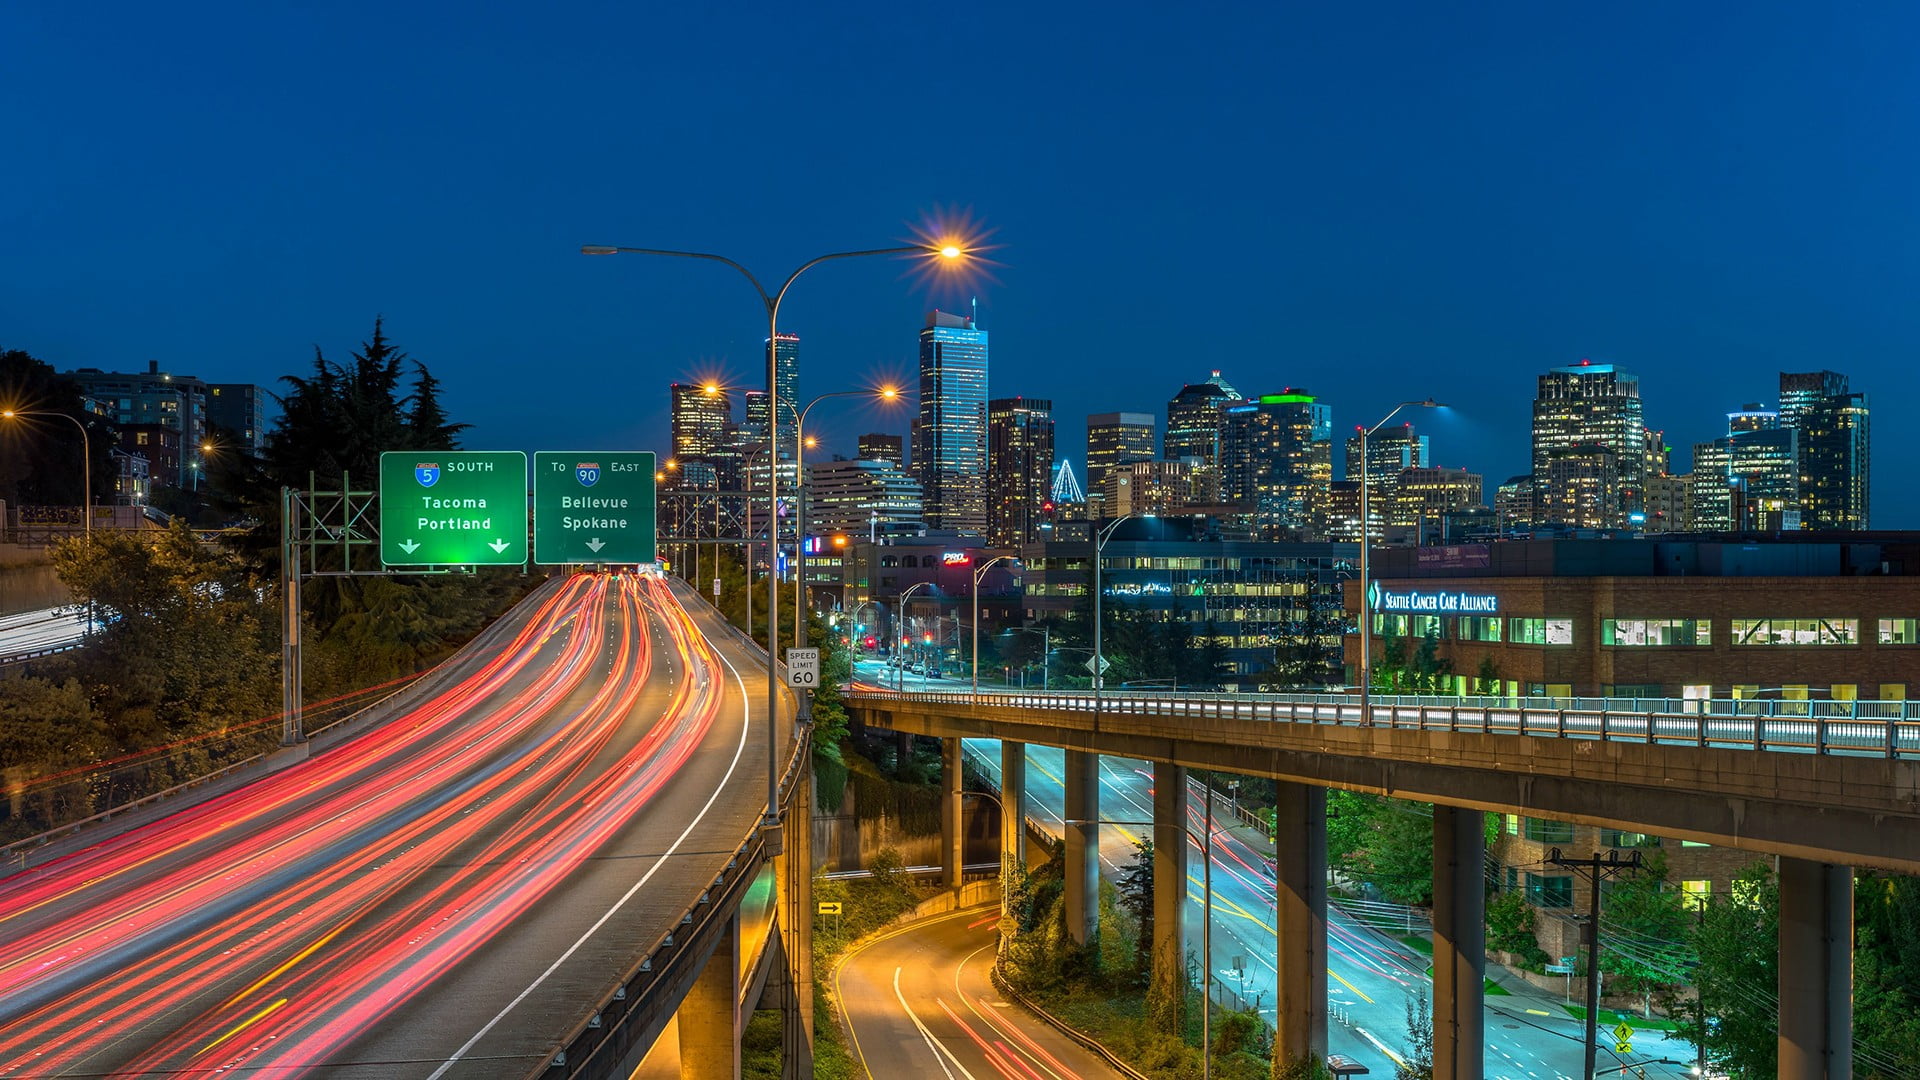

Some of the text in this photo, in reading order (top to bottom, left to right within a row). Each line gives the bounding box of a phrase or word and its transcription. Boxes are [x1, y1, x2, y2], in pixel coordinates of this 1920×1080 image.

[423, 469, 433, 483] 5
[447, 462, 494, 472] SOUTH
[579, 470, 596, 482] 90
[611, 462, 639, 472] EAST
[422, 496, 487, 509] Tacoma
[562, 496, 629, 509] Bellevue
[418, 517, 491, 530] Portland
[562, 516, 628, 531] Spokane
[943, 553, 964, 561] PRO
[1385, 592, 1497, 611] SEATTLE CANCER CARE ALLIANCE
[790, 652, 817, 660] SPEED
[793, 671, 814, 684] 60
